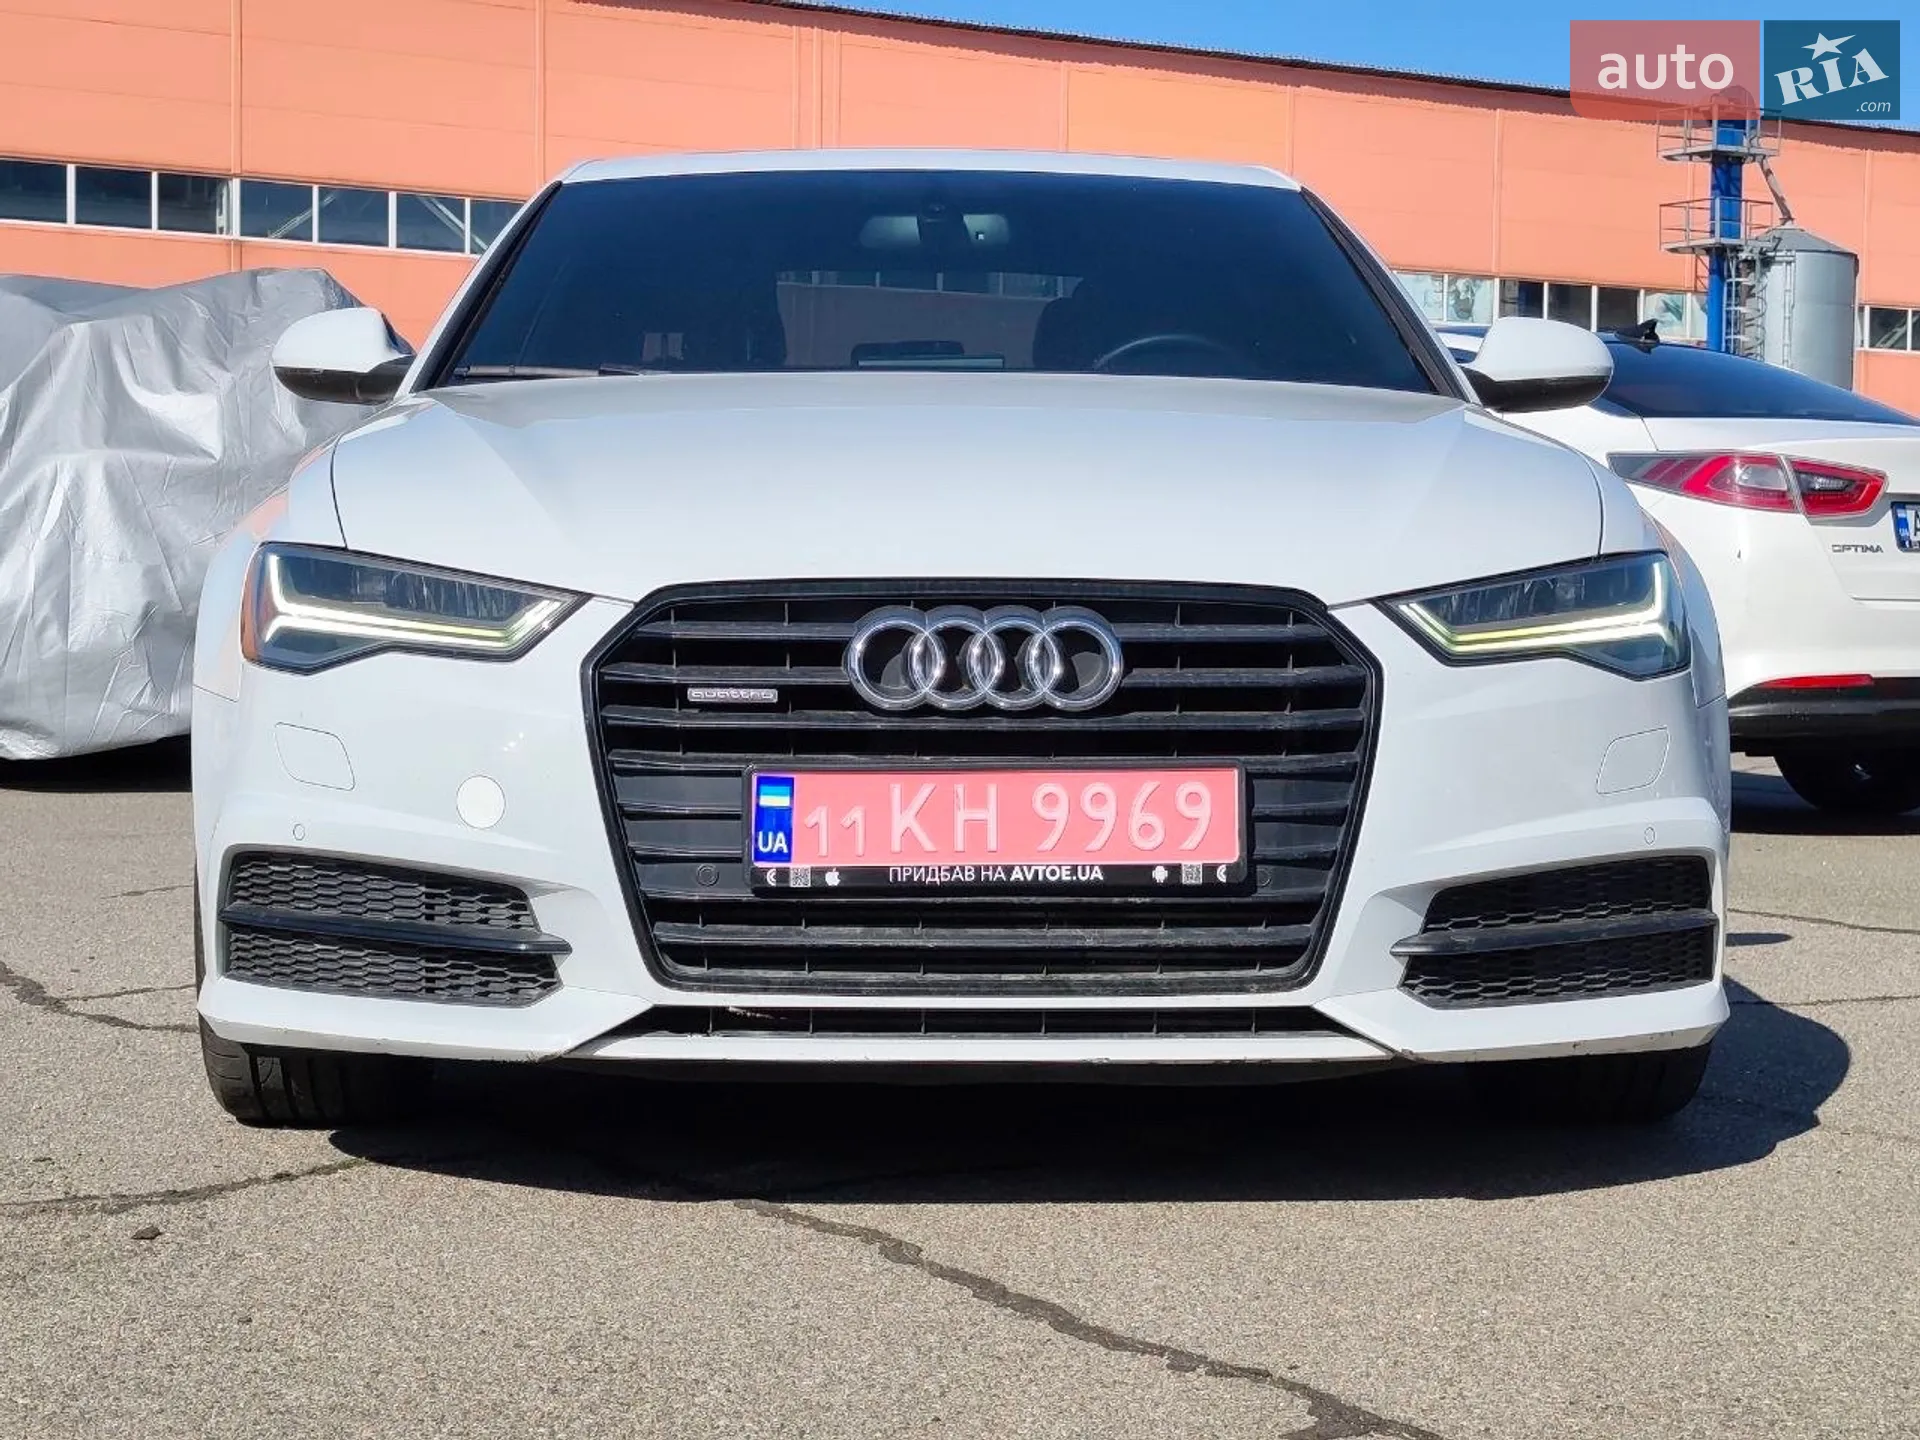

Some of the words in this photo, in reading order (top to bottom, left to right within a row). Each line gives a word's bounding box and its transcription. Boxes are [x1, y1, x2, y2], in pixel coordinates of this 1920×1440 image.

[1831, 544, 1884, 553] OPTIMA
[690, 689, 775, 700] quattro
[804, 806, 865, 857] 11
[1031, 781, 1213, 852] 9969
[757, 831, 789, 853] UA
[889, 866, 975, 884] ПРИДБАВ
[980, 866, 1006, 881] НА
[1009, 865, 1104, 881] AVTOE.UA
